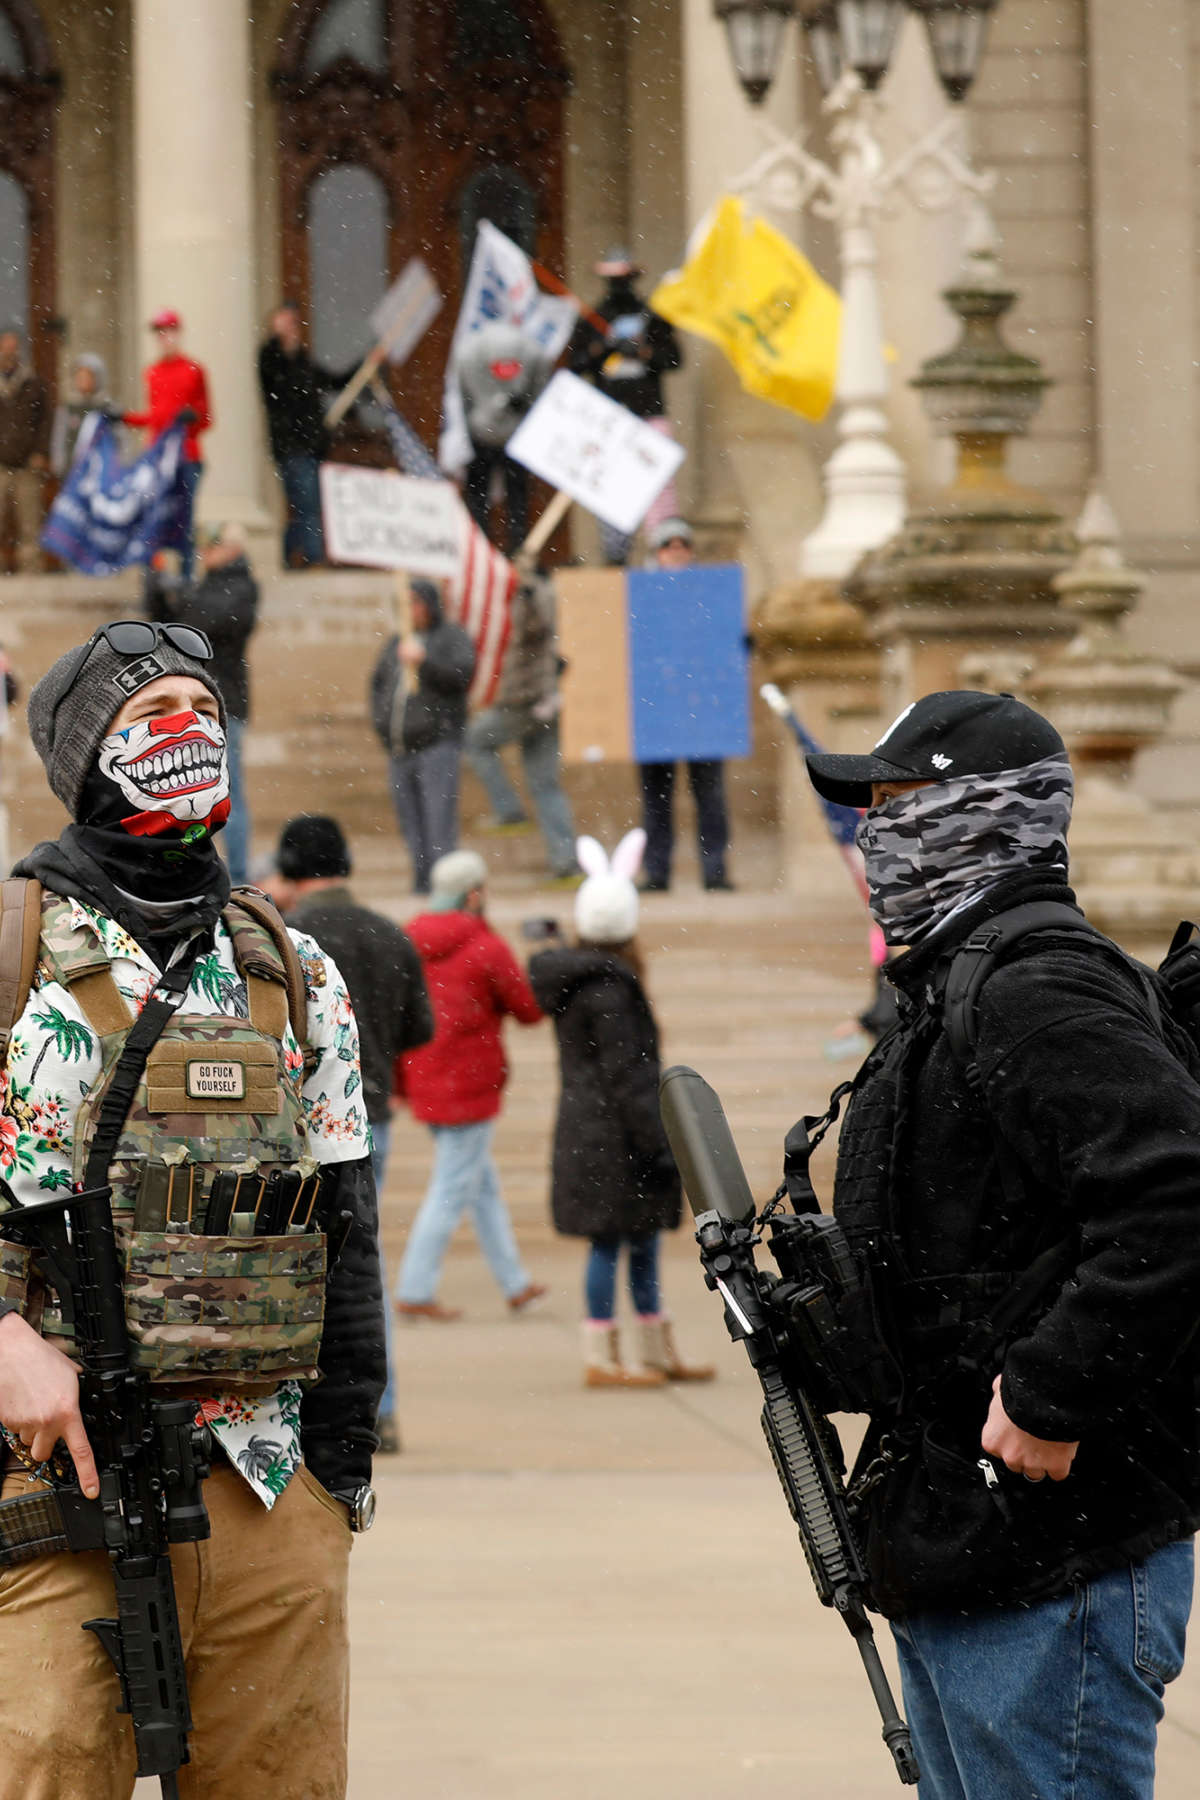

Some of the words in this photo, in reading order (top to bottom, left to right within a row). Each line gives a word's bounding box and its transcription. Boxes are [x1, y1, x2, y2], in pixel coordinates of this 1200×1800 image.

[199, 1066, 211, 1077] GO
[213, 1066, 234, 1078] FUCK
[196, 1080, 237, 1092] YOURSELF
